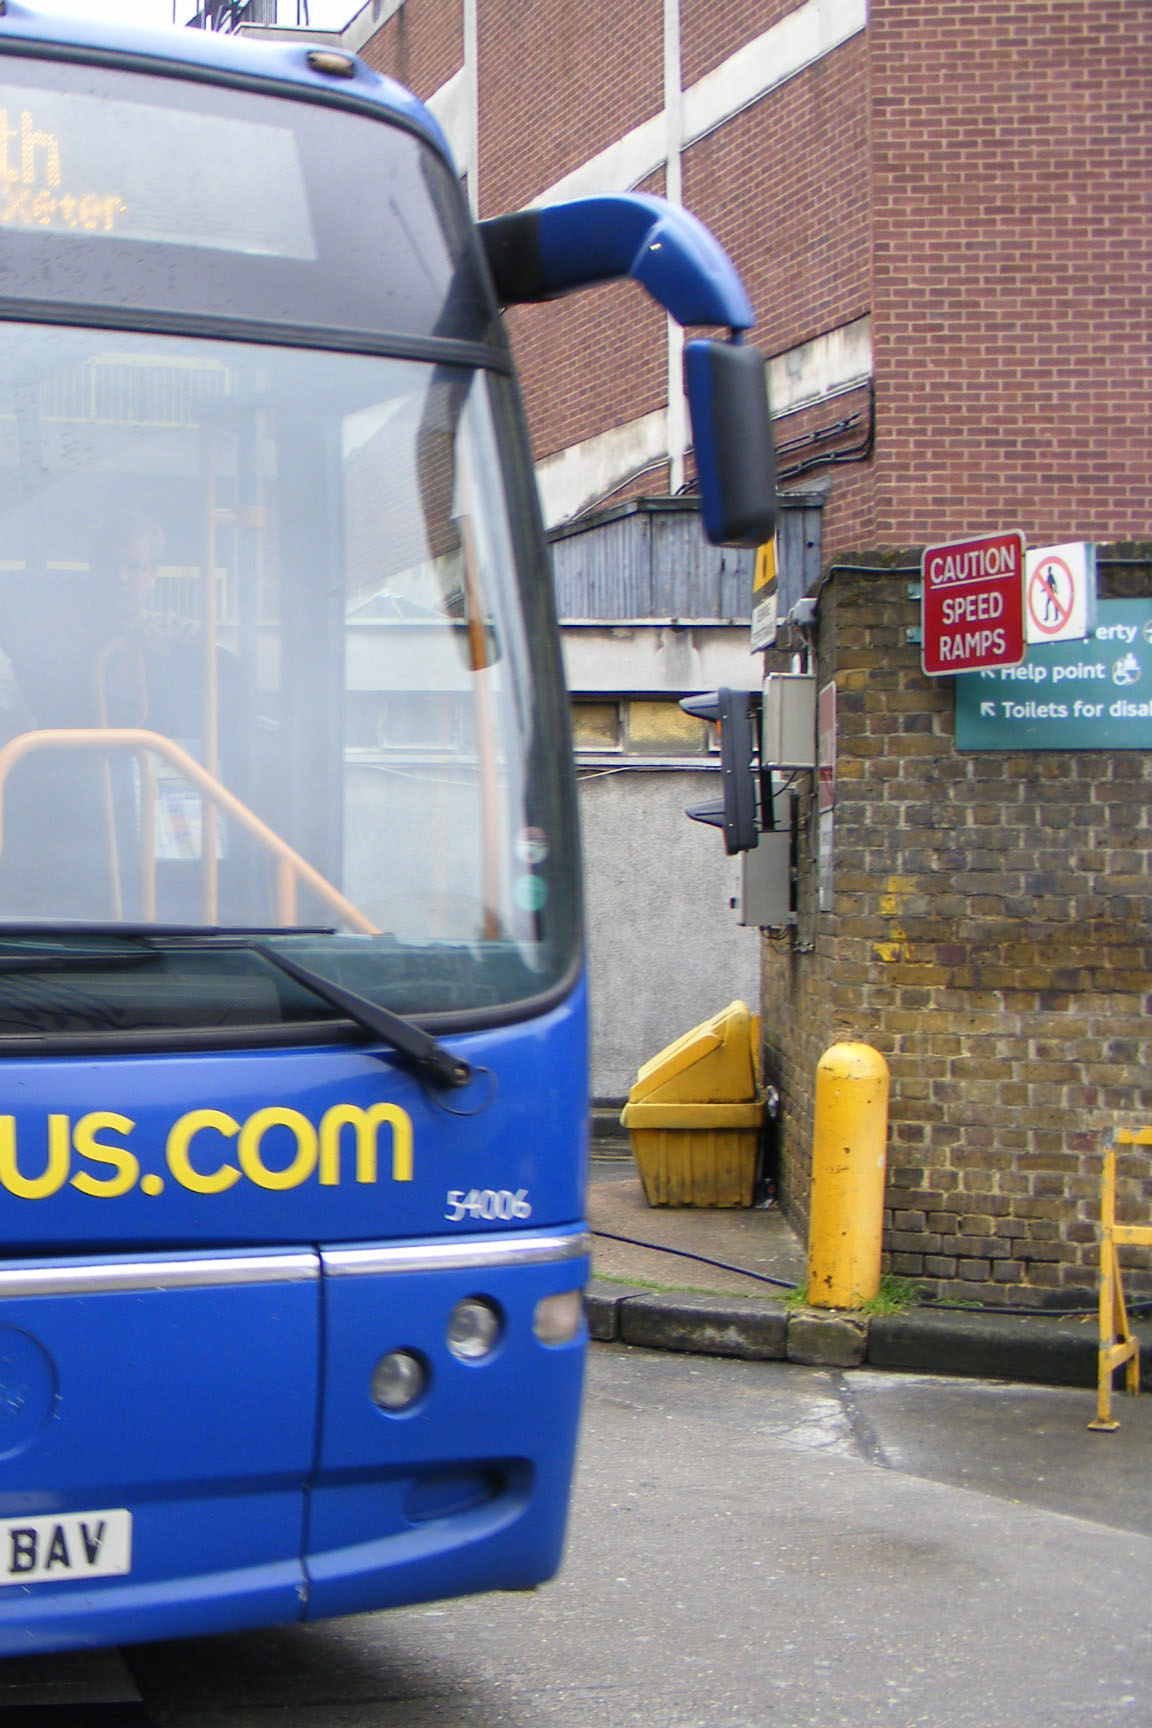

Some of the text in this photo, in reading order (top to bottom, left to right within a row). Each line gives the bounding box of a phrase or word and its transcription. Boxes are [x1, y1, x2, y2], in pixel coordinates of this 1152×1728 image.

[929, 544, 1016, 585] CAUTION
[941, 591, 1004, 625] SPEED
[939, 628, 1006, 662] RAMPS
[1084, 624, 1138, 645] erty
[1000, 662, 1106, 684] Help point
[1002, 700, 1152, 719] Toilets for disa
[444, 1188, 532, 1222] 54006
[9, 1520, 106, 1574] BAV
